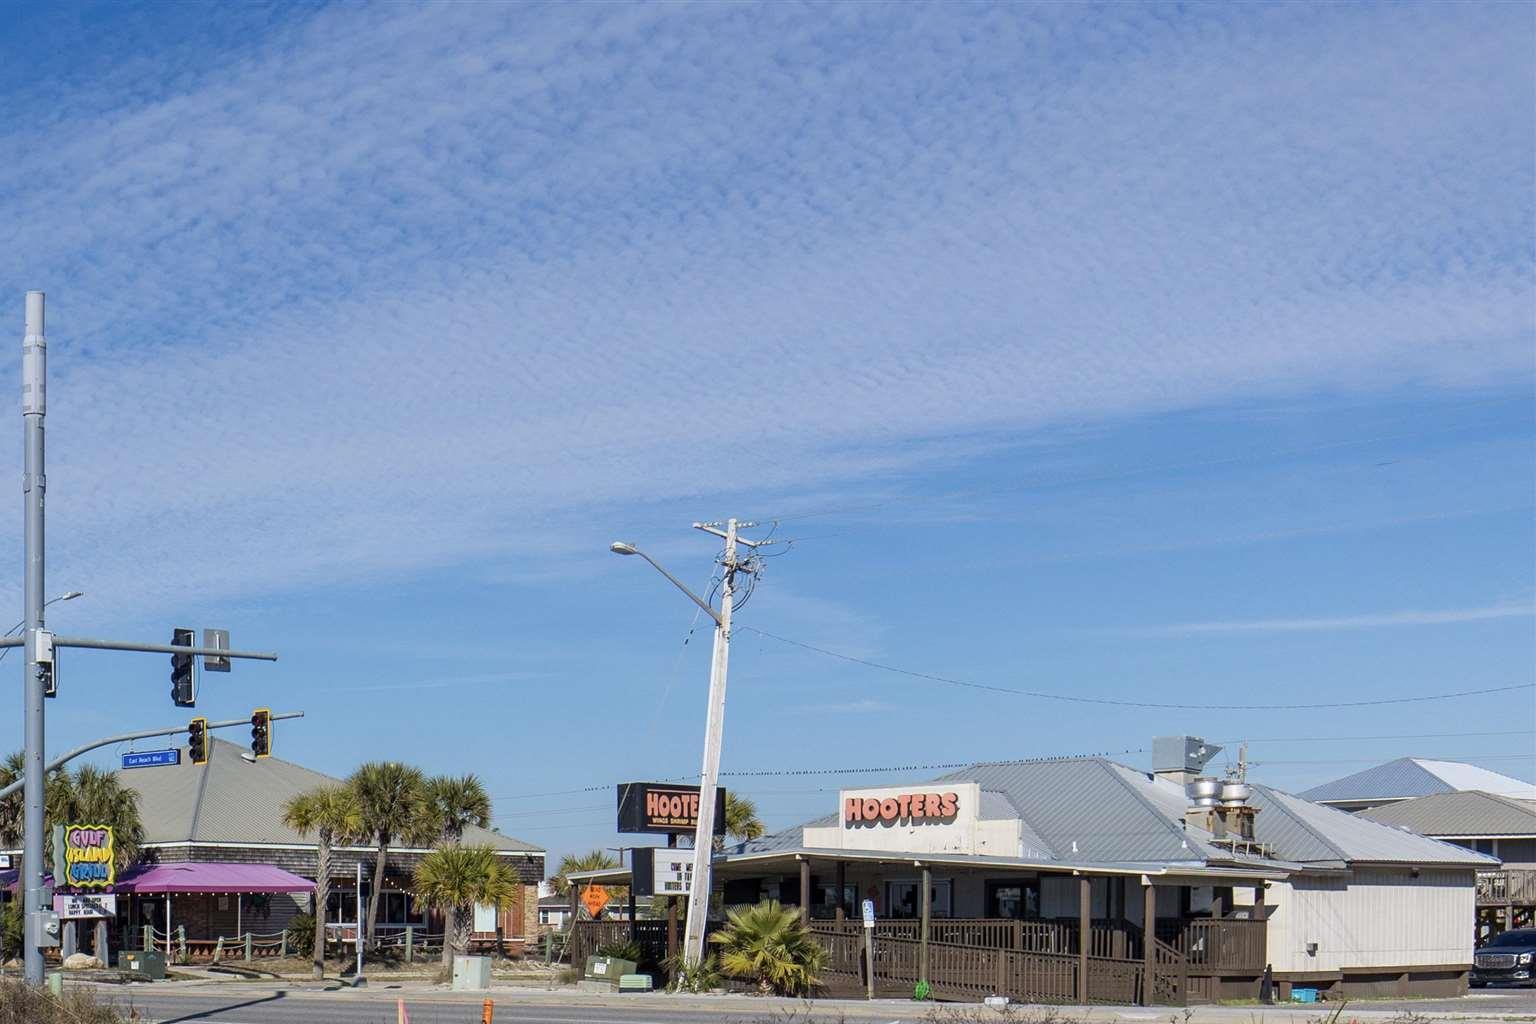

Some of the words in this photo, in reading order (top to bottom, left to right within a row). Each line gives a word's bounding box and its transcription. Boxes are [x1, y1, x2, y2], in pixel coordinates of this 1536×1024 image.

[647, 793, 699, 818] HOOTE
[845, 793, 958, 823] HOOTERS
[652, 817, 669, 825] WINGS
[72, 829, 106, 848] GULF
[68, 846, 112, 864] ISLAND
[71, 863, 108, 881] GRILL
